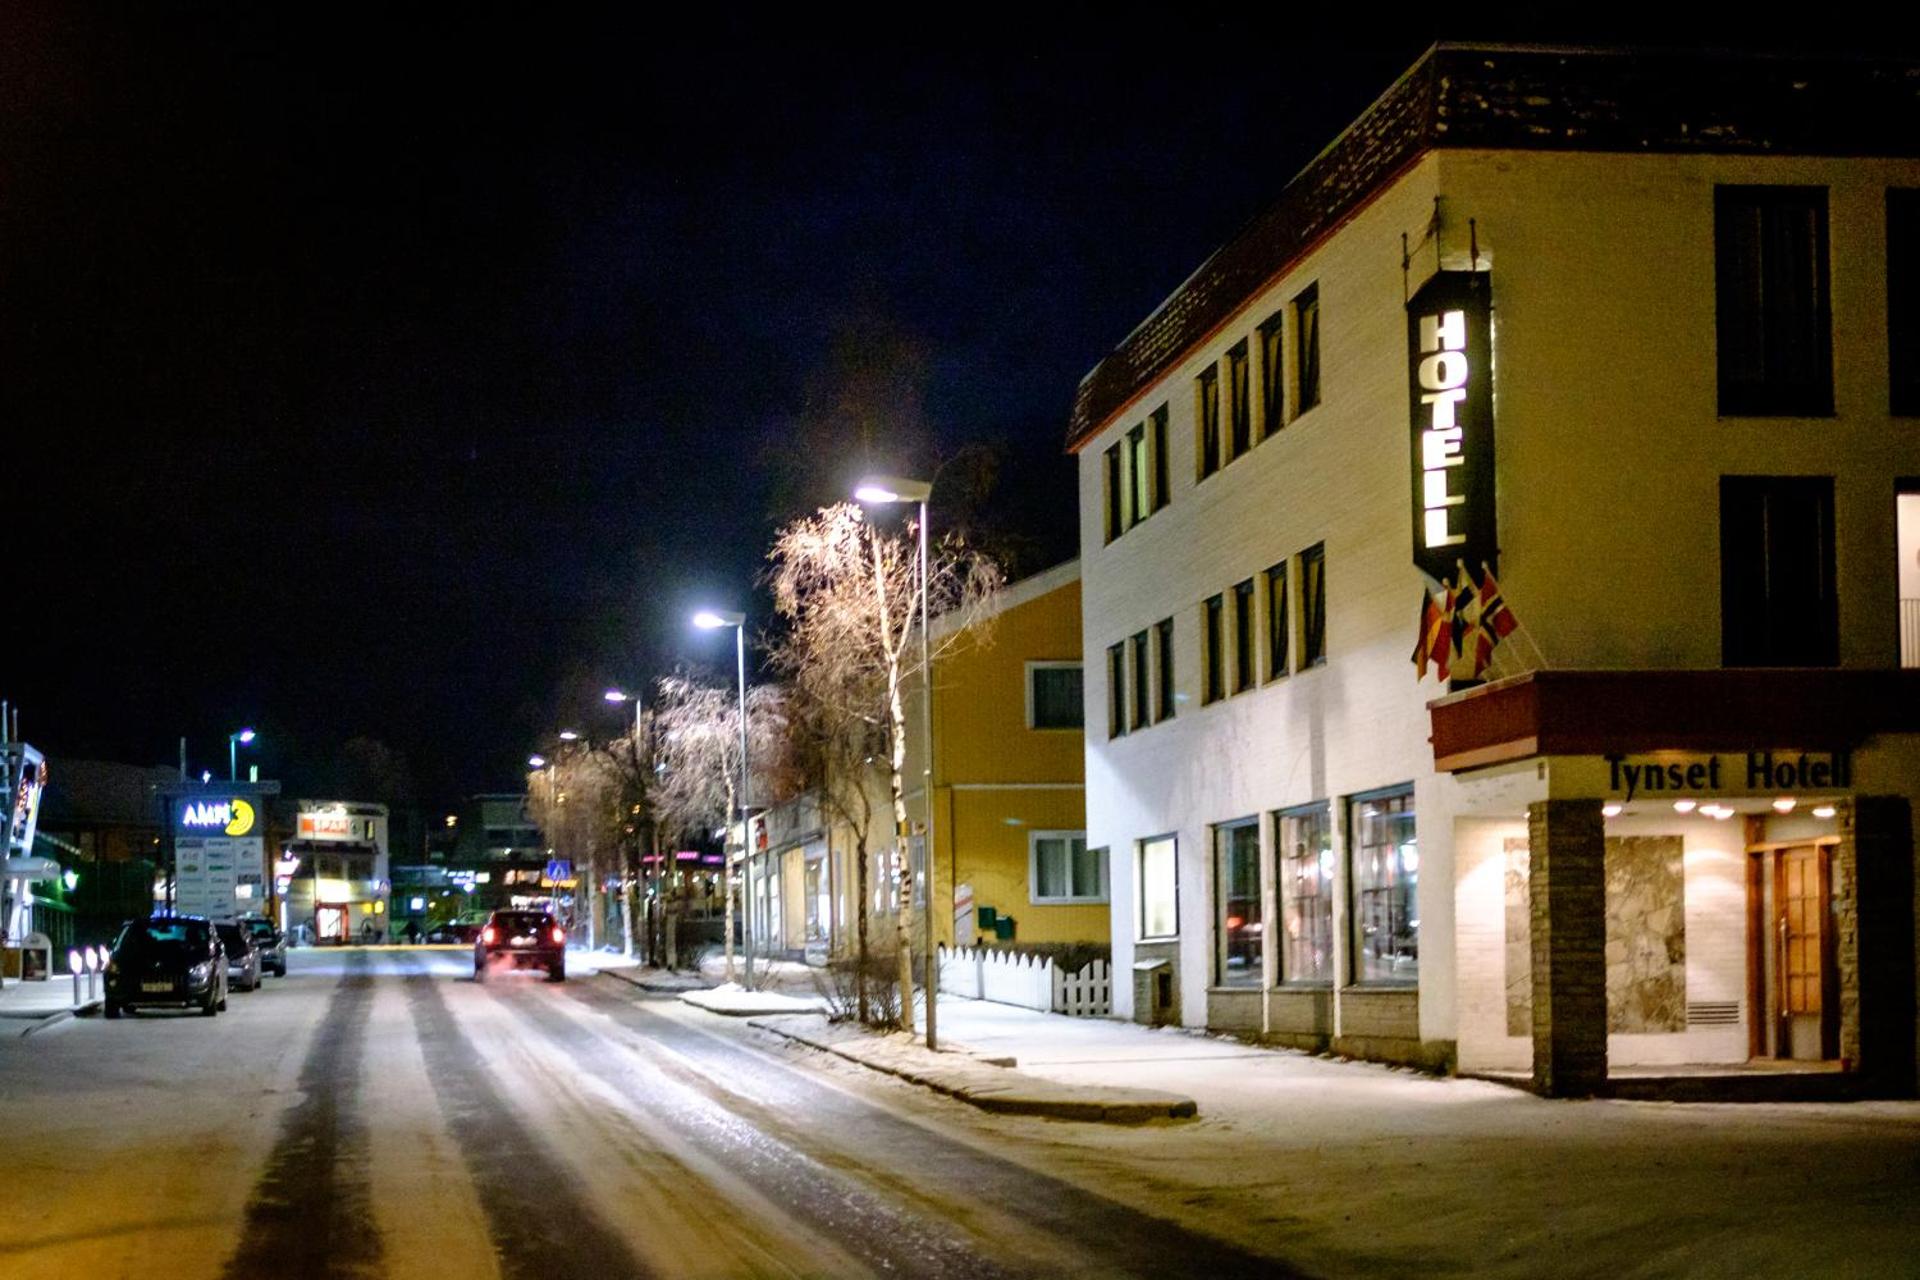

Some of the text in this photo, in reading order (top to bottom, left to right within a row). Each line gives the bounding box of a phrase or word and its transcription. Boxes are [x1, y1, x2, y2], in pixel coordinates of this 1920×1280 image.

[1418, 311, 1468, 548] HOTELL
[1604, 751, 1851, 802] Tynset Hotell
